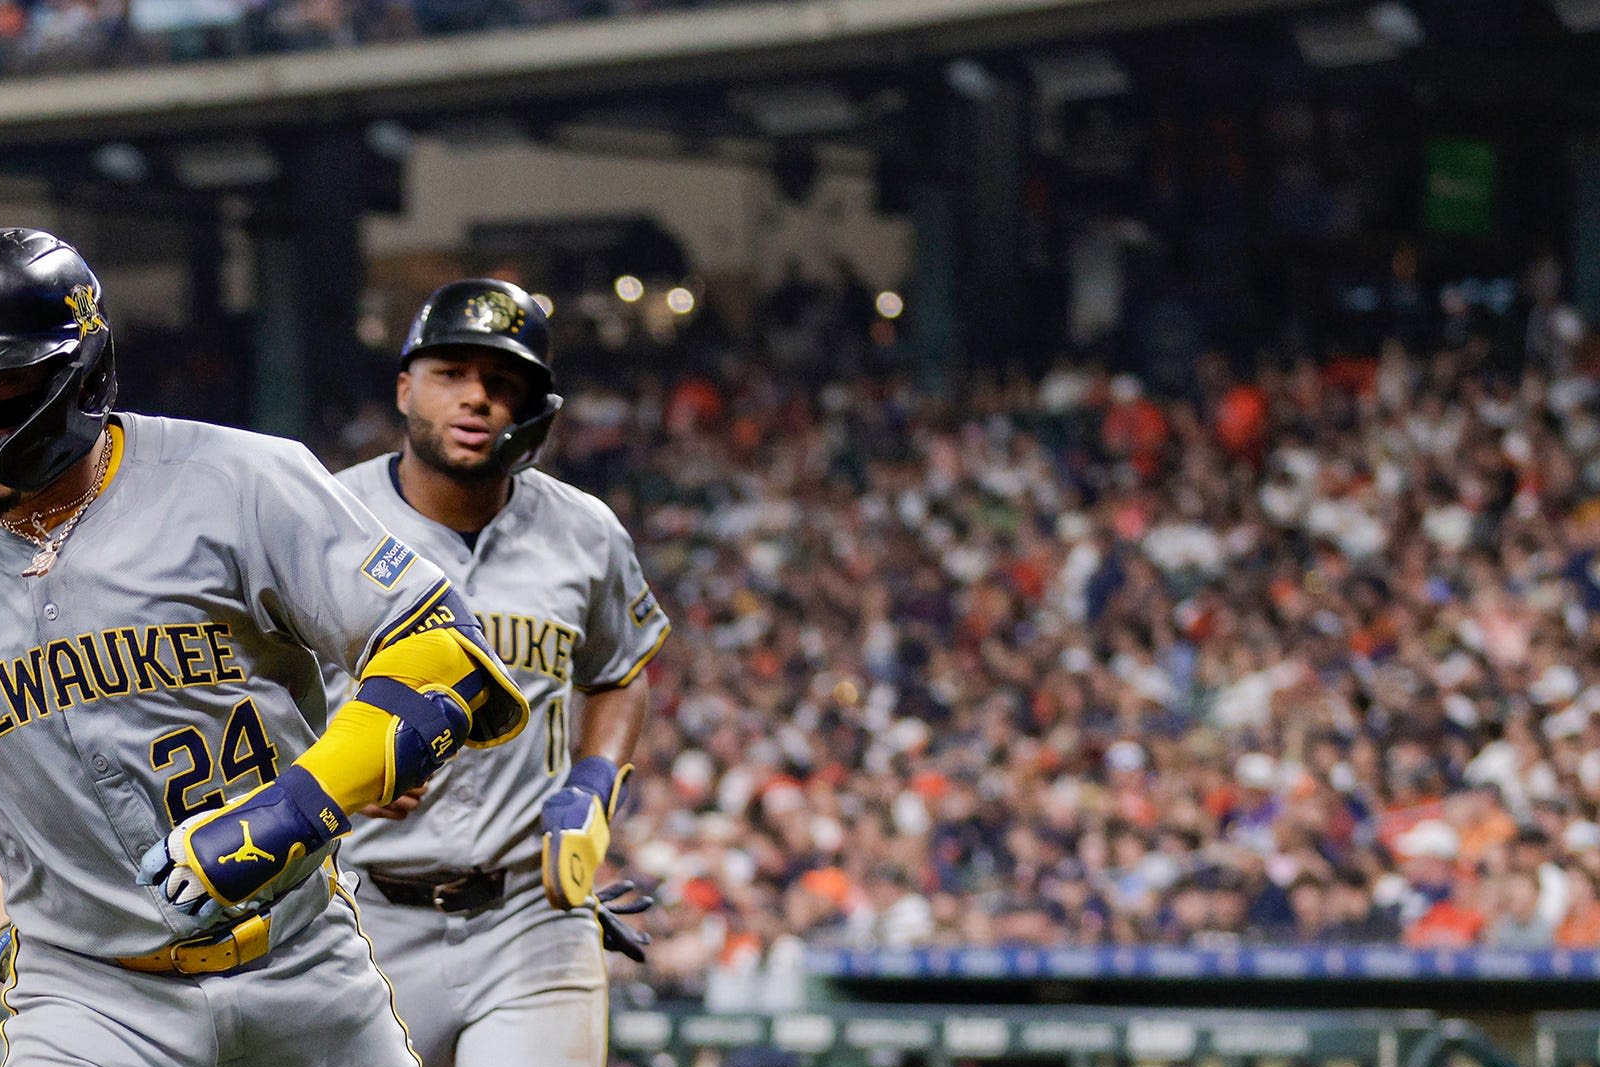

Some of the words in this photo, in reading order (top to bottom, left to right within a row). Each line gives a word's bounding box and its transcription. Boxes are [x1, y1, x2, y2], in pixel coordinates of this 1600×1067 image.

[430, 728, 455, 758] 24
[150, 696, 280, 828] 24
[319, 807, 339, 833] WC24
